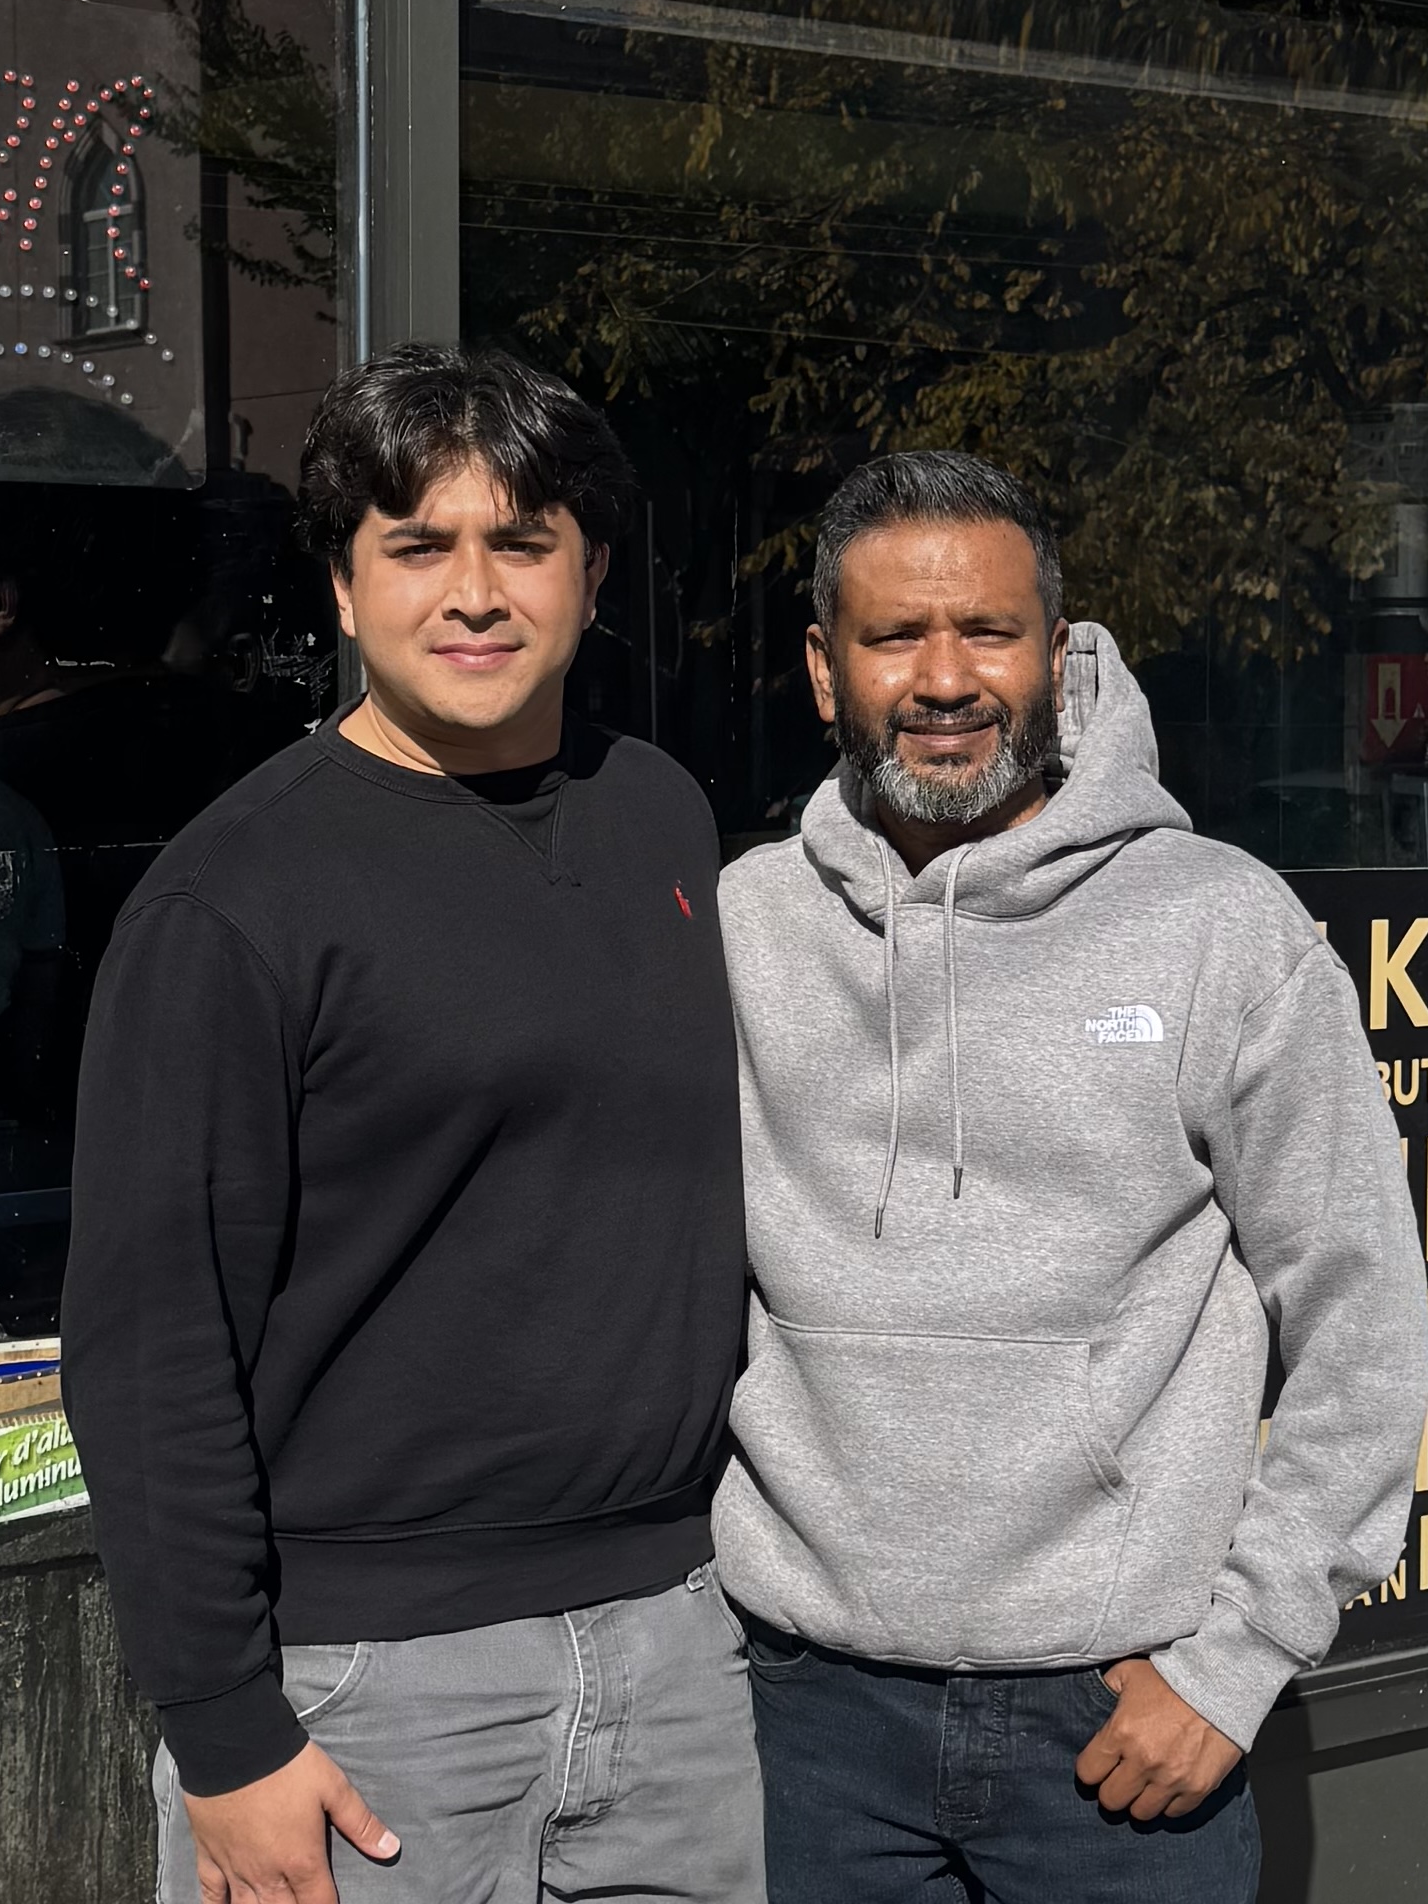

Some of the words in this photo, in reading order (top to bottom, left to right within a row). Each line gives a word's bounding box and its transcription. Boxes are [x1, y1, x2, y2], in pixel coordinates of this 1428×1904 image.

[1108, 1005, 1136, 1018] THE
[1085, 1018, 1135, 1032] NORTH
[1098, 1031, 1135, 1043] FACE
[13, 1421, 75, 1466] d'alu
